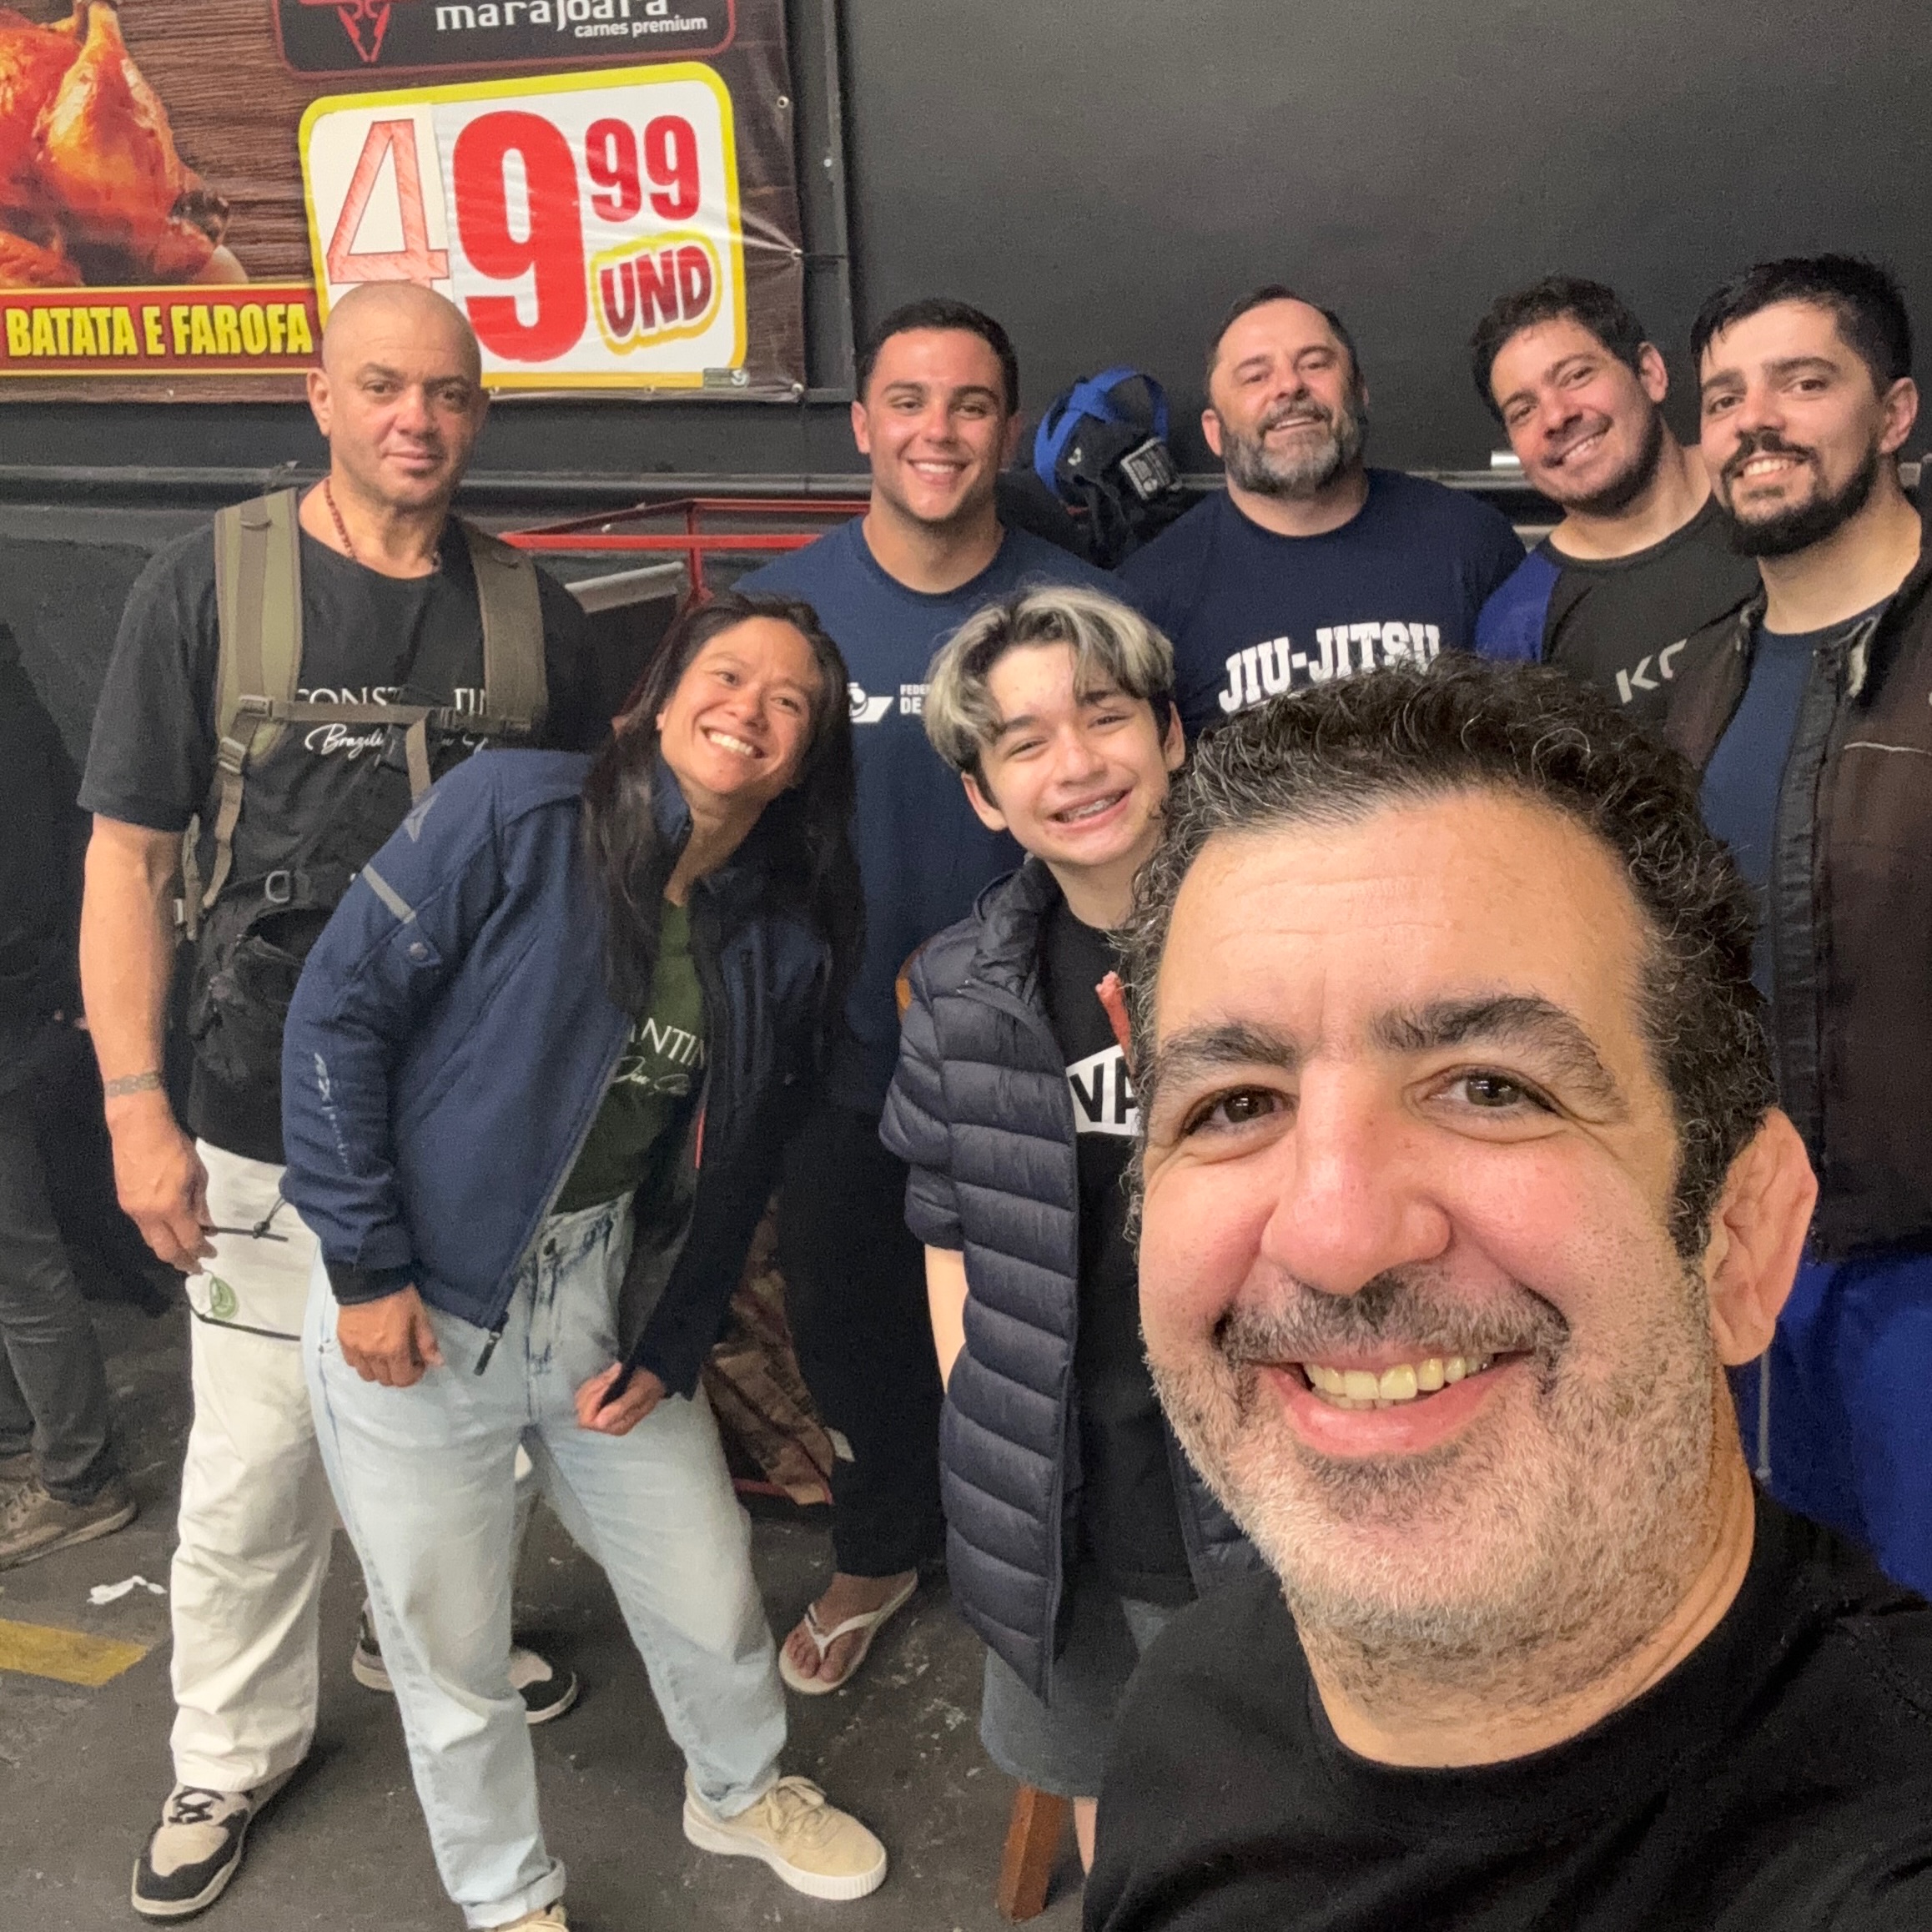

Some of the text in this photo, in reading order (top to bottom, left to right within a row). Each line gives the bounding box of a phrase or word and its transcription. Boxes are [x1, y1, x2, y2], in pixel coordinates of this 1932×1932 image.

[574, 14, 708, 38] carnes premium
[600, 245, 712, 337] UND
[6, 304, 313, 356] BATATA E FAROFA
[1218, 621, 1440, 713] JIU-JITSU
